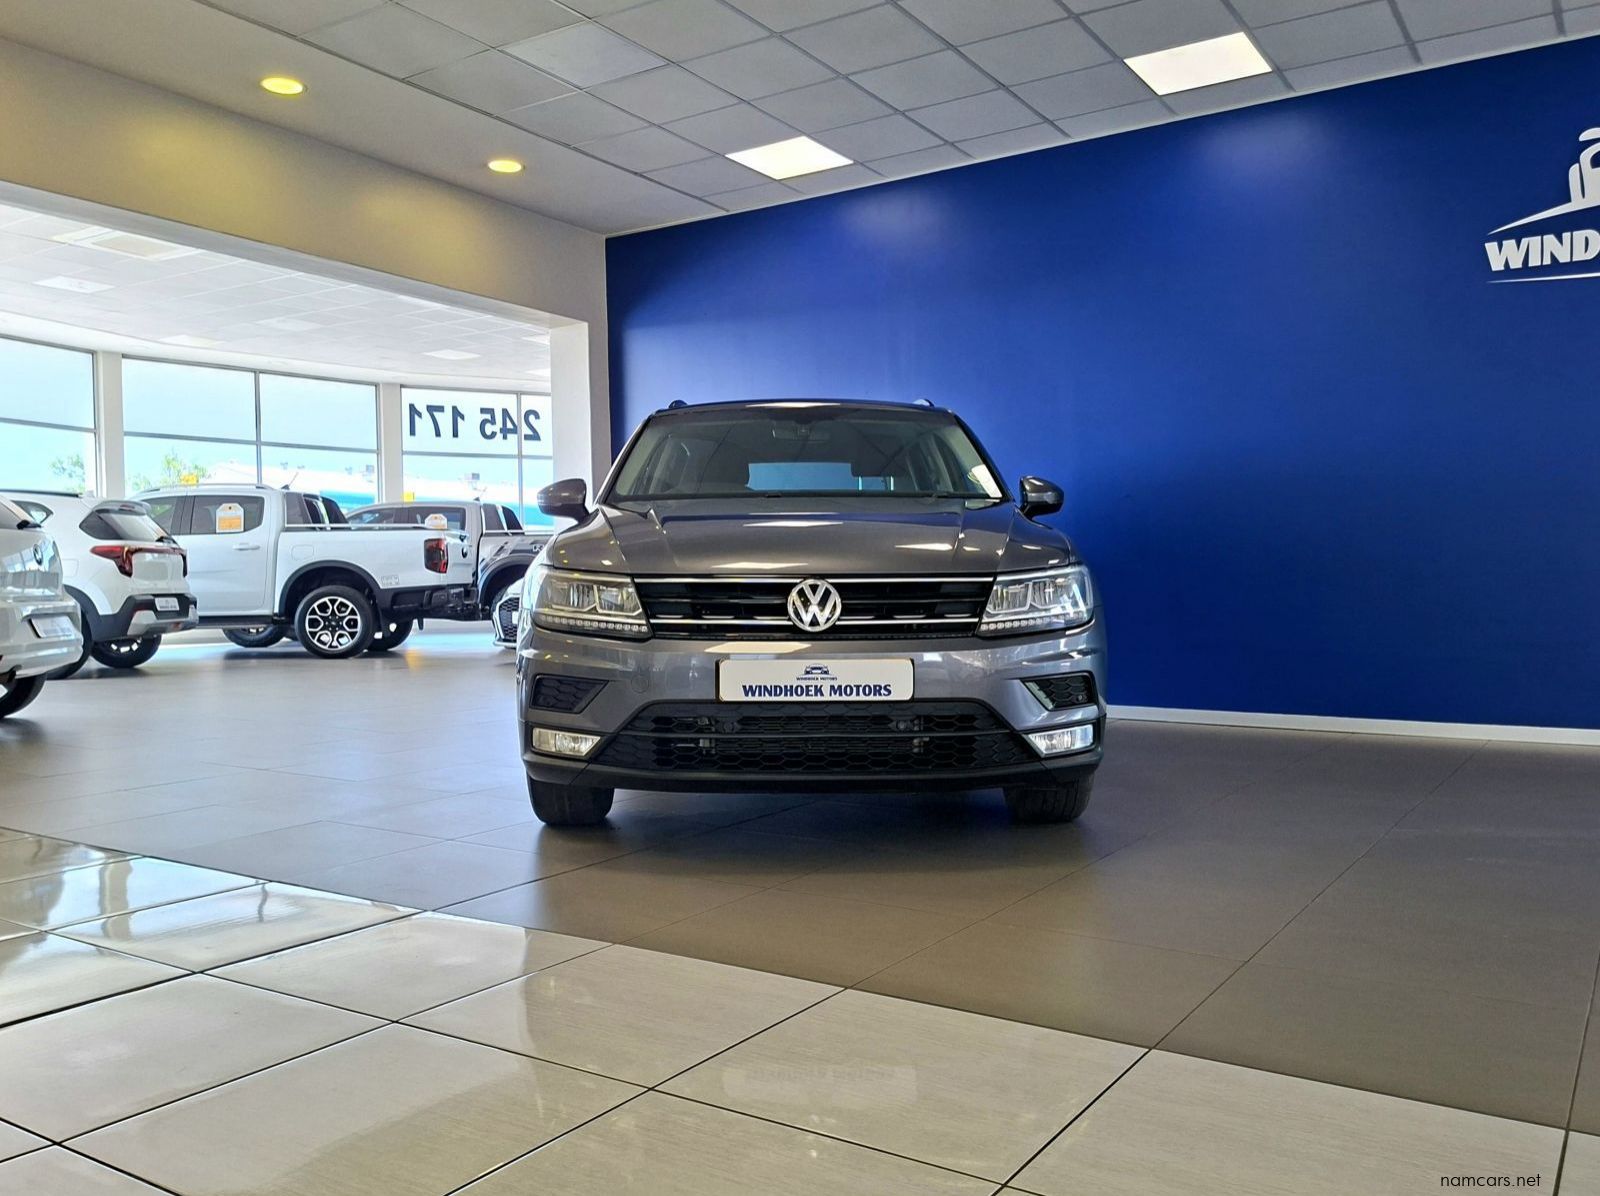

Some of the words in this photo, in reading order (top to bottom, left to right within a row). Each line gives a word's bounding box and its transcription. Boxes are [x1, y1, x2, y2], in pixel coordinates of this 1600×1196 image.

[787, 579, 842, 632] VW
[742, 684, 825, 697] WINDHOEK
[829, 684, 892, 697] MOTORS
